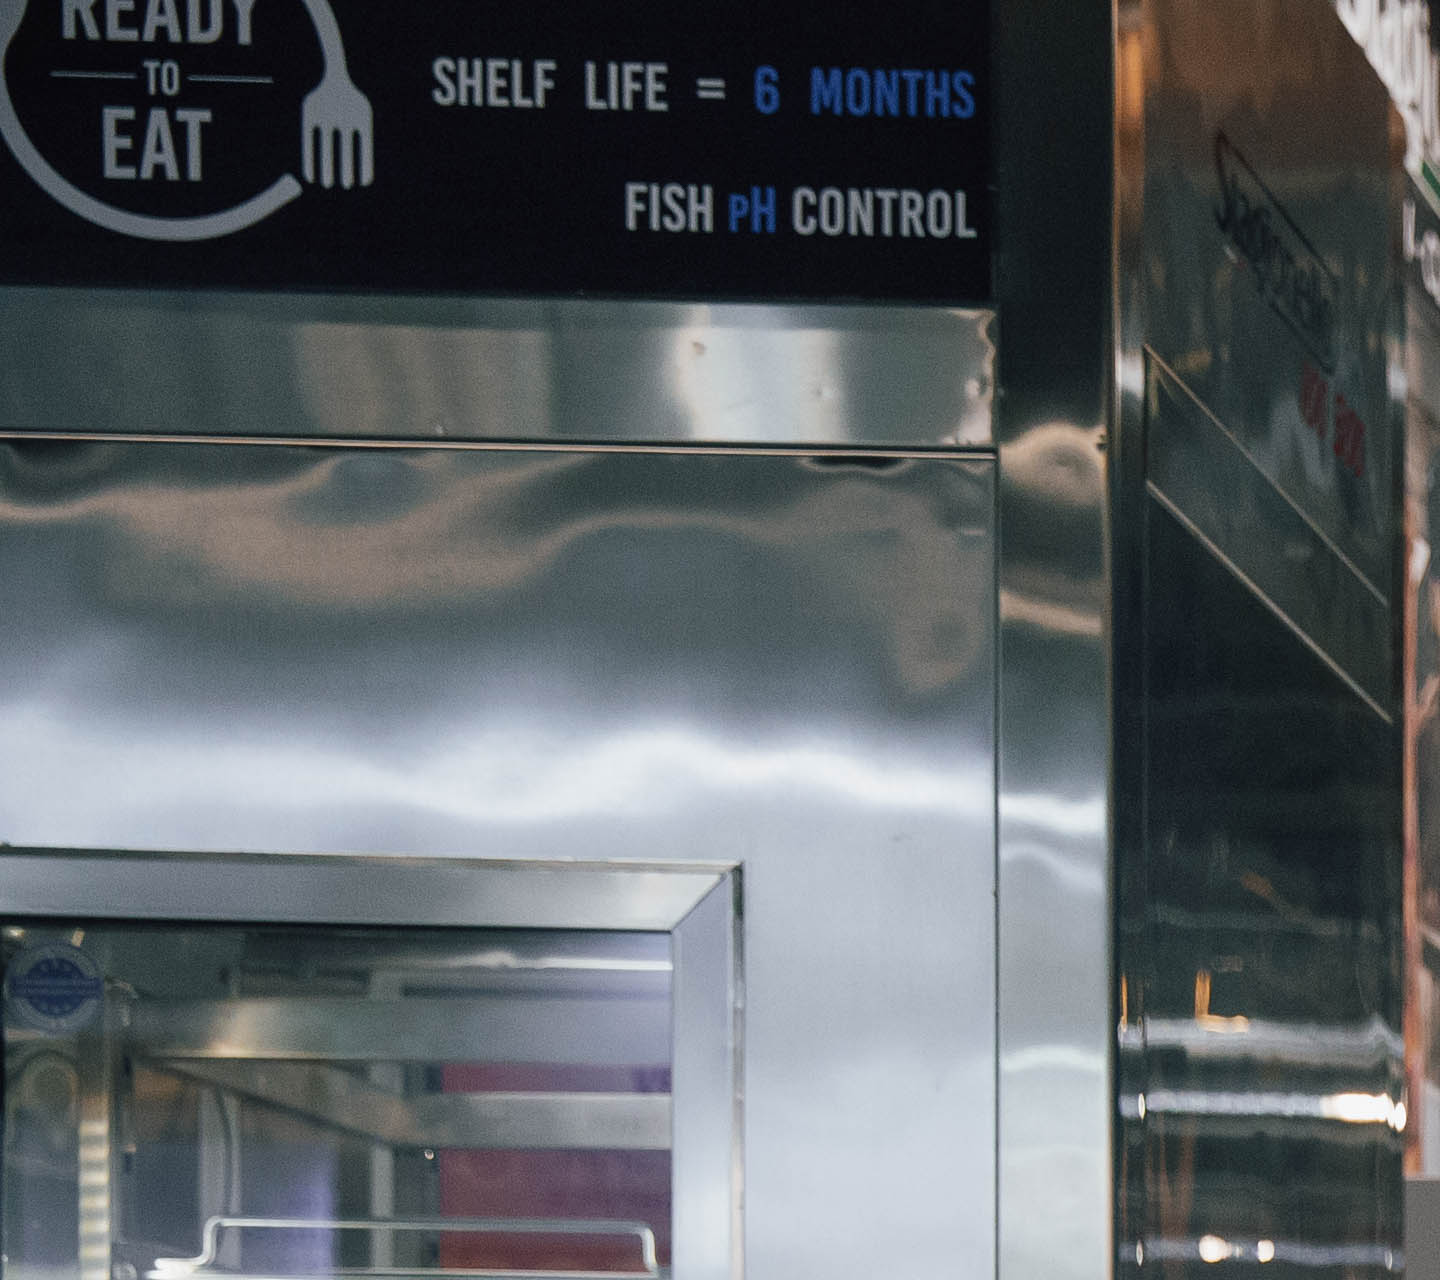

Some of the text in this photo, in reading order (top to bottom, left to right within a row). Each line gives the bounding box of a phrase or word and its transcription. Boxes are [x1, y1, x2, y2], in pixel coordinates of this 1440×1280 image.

[142, 59, 181, 97] TO
[432, 57, 557, 109] SHELF
[584, 61, 669, 112] LIFE
[753, 65, 781, 115] 6
[810, 67, 977, 120] MONTHS
[102, 105, 213, 182] EAT
[625, 181, 978, 240] FISH pH CONTROL
